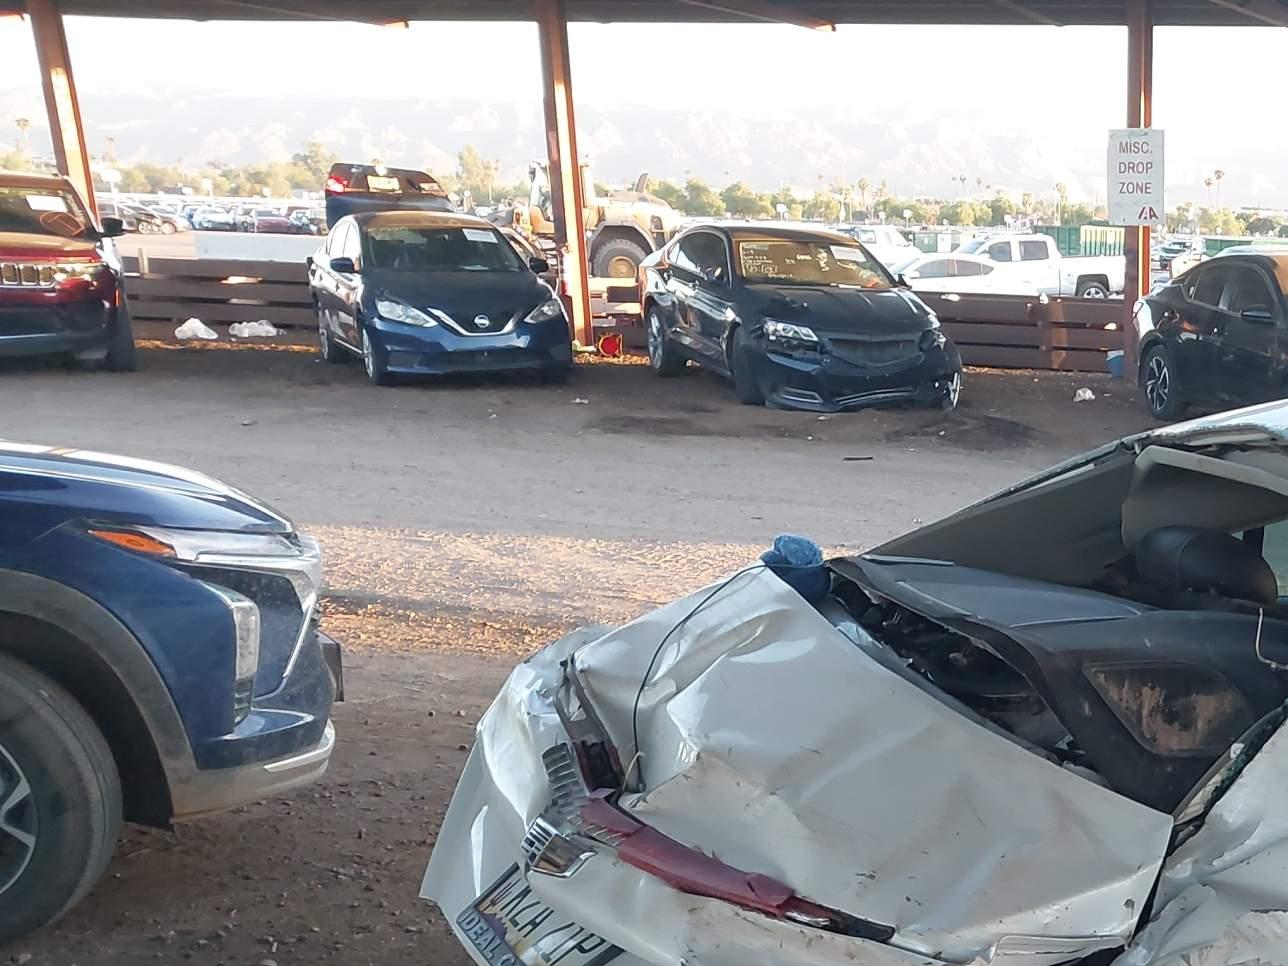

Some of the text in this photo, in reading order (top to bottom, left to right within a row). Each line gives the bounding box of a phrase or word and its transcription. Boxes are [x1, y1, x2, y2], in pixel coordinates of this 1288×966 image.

[1119, 141, 1153, 154] MISC.
[1118, 161, 1153, 175] DROP
[1119, 181, 1152, 195] ZONE
